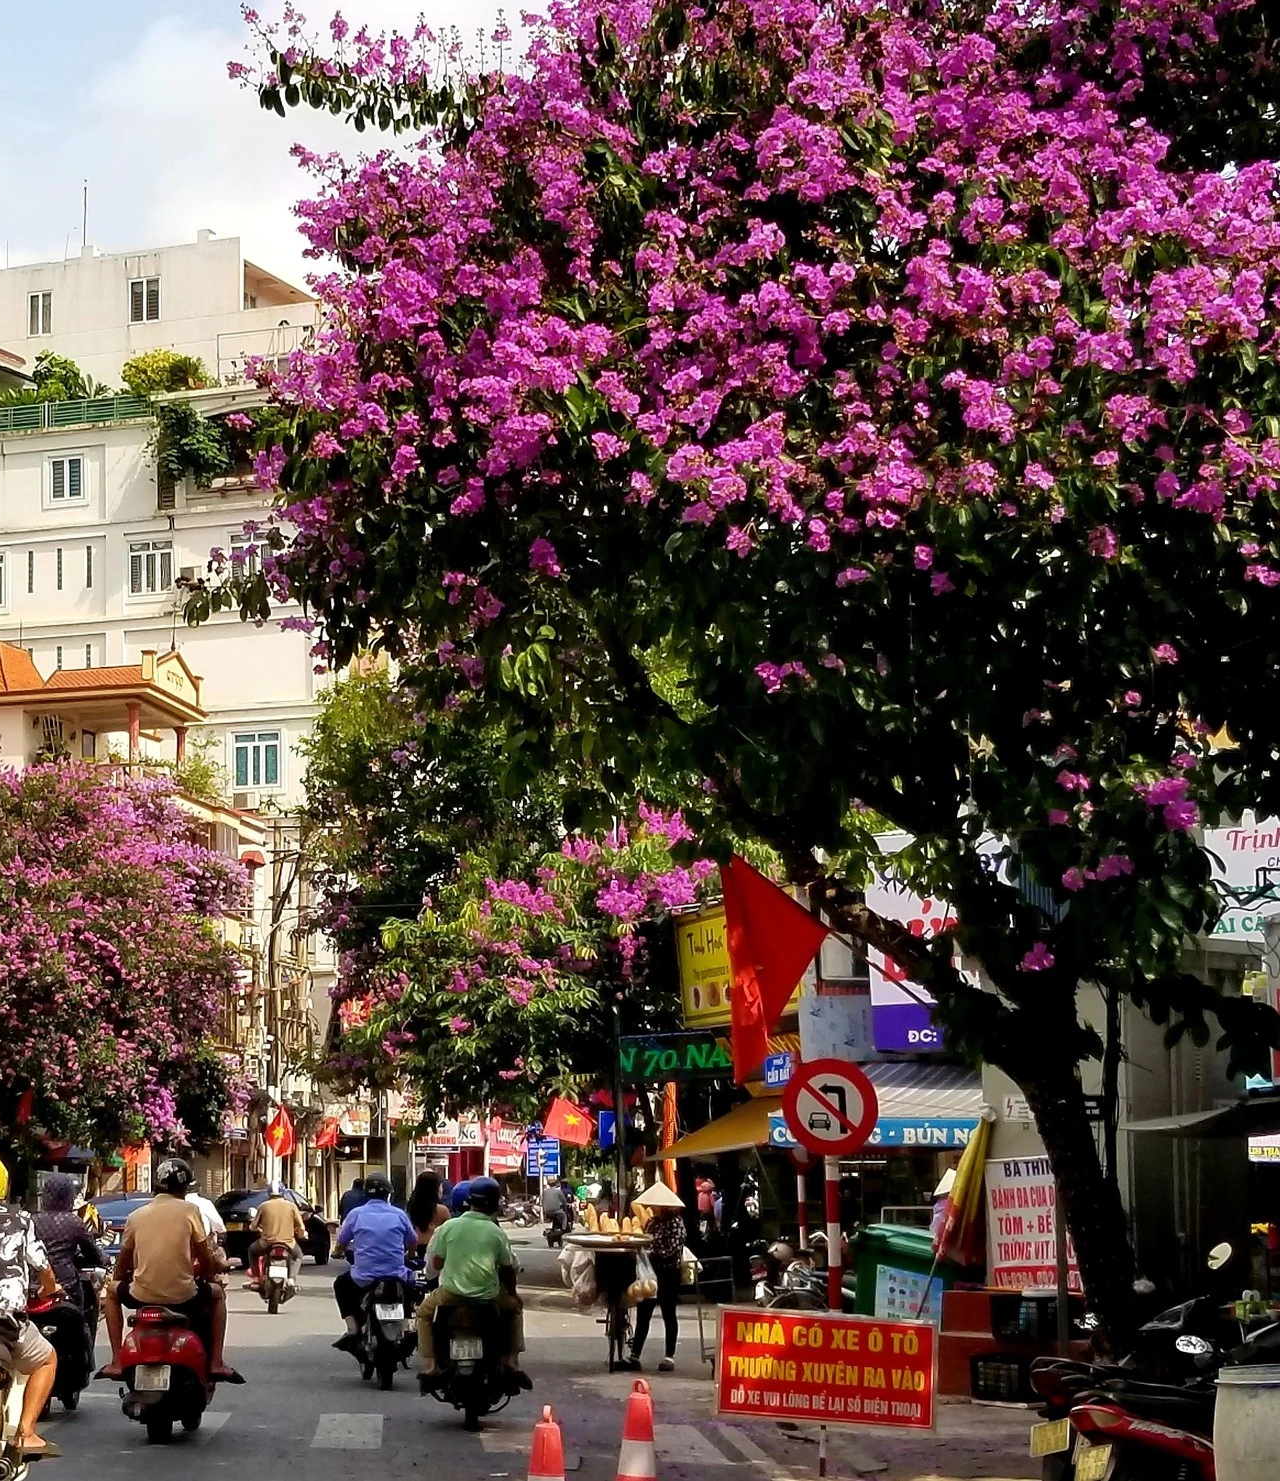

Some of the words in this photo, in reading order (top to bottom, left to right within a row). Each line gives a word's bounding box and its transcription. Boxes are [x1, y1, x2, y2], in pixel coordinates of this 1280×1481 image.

[640, 1050, 678, 1077] 70
[903, 1122, 948, 1144] BÚN
[1003, 1160, 1021, 1178] BÀ
[1030, 1185, 1049, 1208] CUA
[997, 1213, 1024, 1236] TÔM
[997, 1238, 1032, 1262] TRỨNG
[1034, 1241, 1051, 1264] VỊT
[737, 1319, 785, 1346] NHÀ
[792, 1322, 823, 1348] CÓ
[831, 1328, 860, 1351] XE
[868, 1327, 883, 1353] Ô
[891, 1329, 919, 1355] TÔ
[728, 1353, 797, 1382] THƯỜNG
[802, 1360, 858, 1387] XUYÊN
[863, 1367, 886, 1389] RA
[892, 1365, 925, 1392] VÀO
[747, 1390, 761, 1406] XE
[763, 1391, 780, 1406] VUI
[782, 1390, 809, 1411] LÒNG
[828, 1396, 844, 1415] LẠI
[847, 1393, 861, 1412] SỐ
[863, 1398, 888, 1418] ĐIỆN
[890, 1401, 921, 1421] THOẠI
